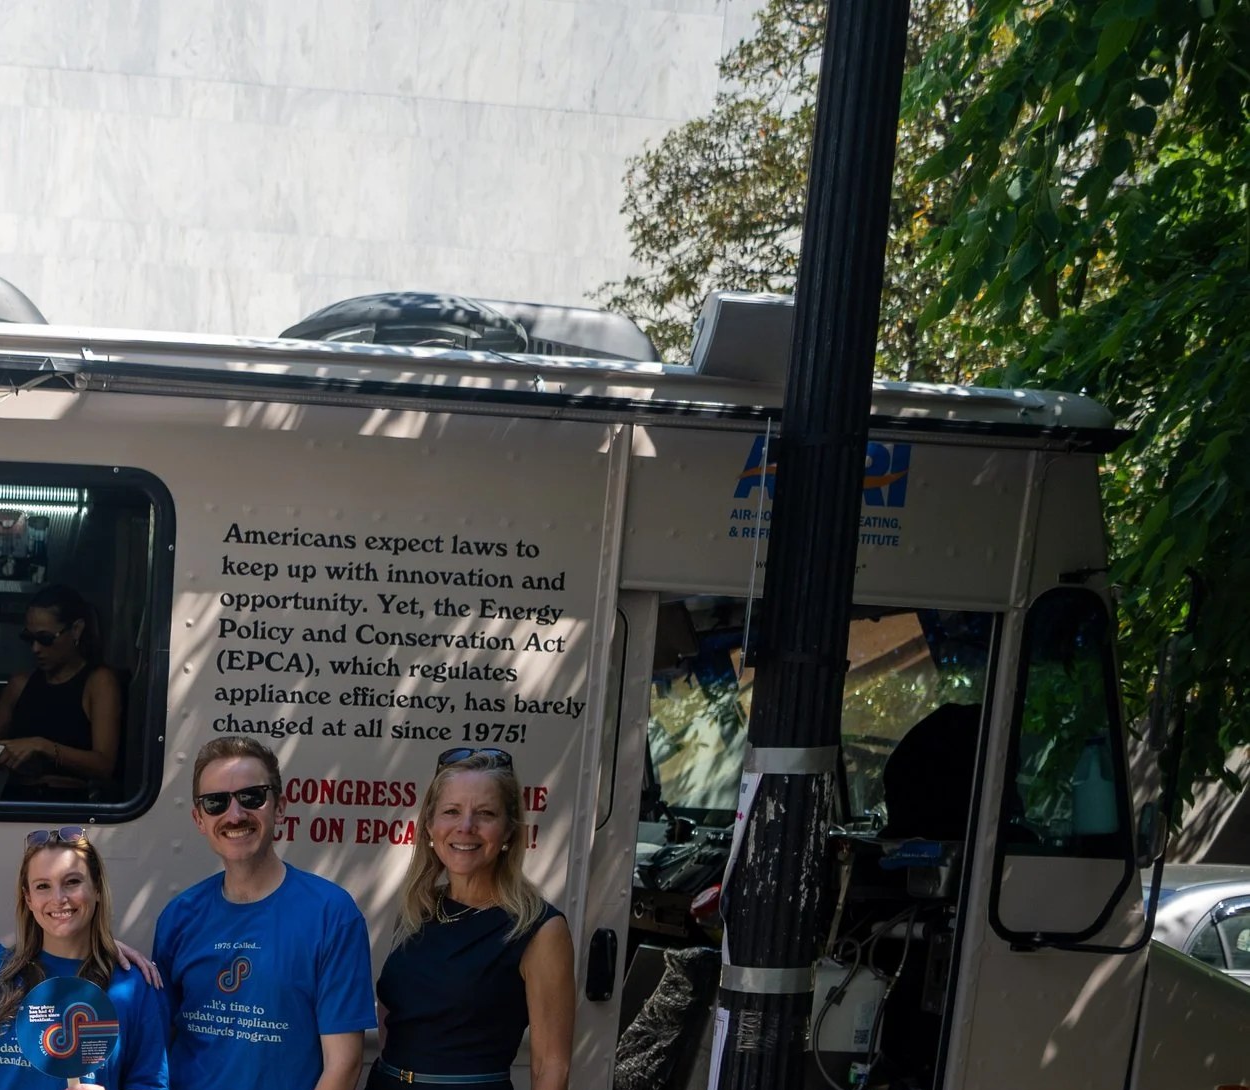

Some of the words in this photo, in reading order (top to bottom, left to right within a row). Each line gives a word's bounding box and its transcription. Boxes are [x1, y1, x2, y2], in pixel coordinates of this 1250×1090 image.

[734, 435, 912, 507] ARI
[858, 516, 902, 530] EATING,
[224, 523, 356, 550] Americans
[365, 534, 444, 554] expect
[452, 535, 508, 558] laws
[516, 540, 539, 559] to
[222, 556, 278, 580] keep
[288, 564, 316, 582] up
[326, 562, 379, 583] with
[388, 564, 513, 588] innovation
[522, 572, 565, 592] and
[220, 592, 368, 615] opportunity.
[377, 594, 424, 618] Yet,
[434, 598, 471, 618] the
[478, 600, 564, 625] Energy
[218, 619, 294, 644] Policy
[302, 624, 346, 644] and
[356, 624, 515, 652] Conservation
[523, 632, 565, 653] Act
[216, 650, 320, 677] (EPCA),
[330, 656, 400, 678] which
[409, 661, 518, 683] regulates
[214, 684, 330, 706] appliance
[339, 688, 454, 713] efficiency,
[464, 692, 506, 713] has
[514, 696, 586, 719] barely
[213, 715, 314, 738] changed
[322, 719, 346, 737] at
[354, 719, 382, 738] all
[391, 722, 451, 740] since
[462, 723, 527, 743] 1975!
[286, 778, 417, 808] CONGRESS
[310, 818, 345, 844] ON
[233, 942, 261, 950] Called...
[182, 1010, 215, 1022] update
[216, 1015, 236, 1024] our
[237, 1017, 289, 1030] appliance
[203, 1000, 226, 1011] ...It's
[252, 1005, 265, 1015] to
[188, 1023, 234, 1037] standards
[236, 1030, 282, 1043] program
